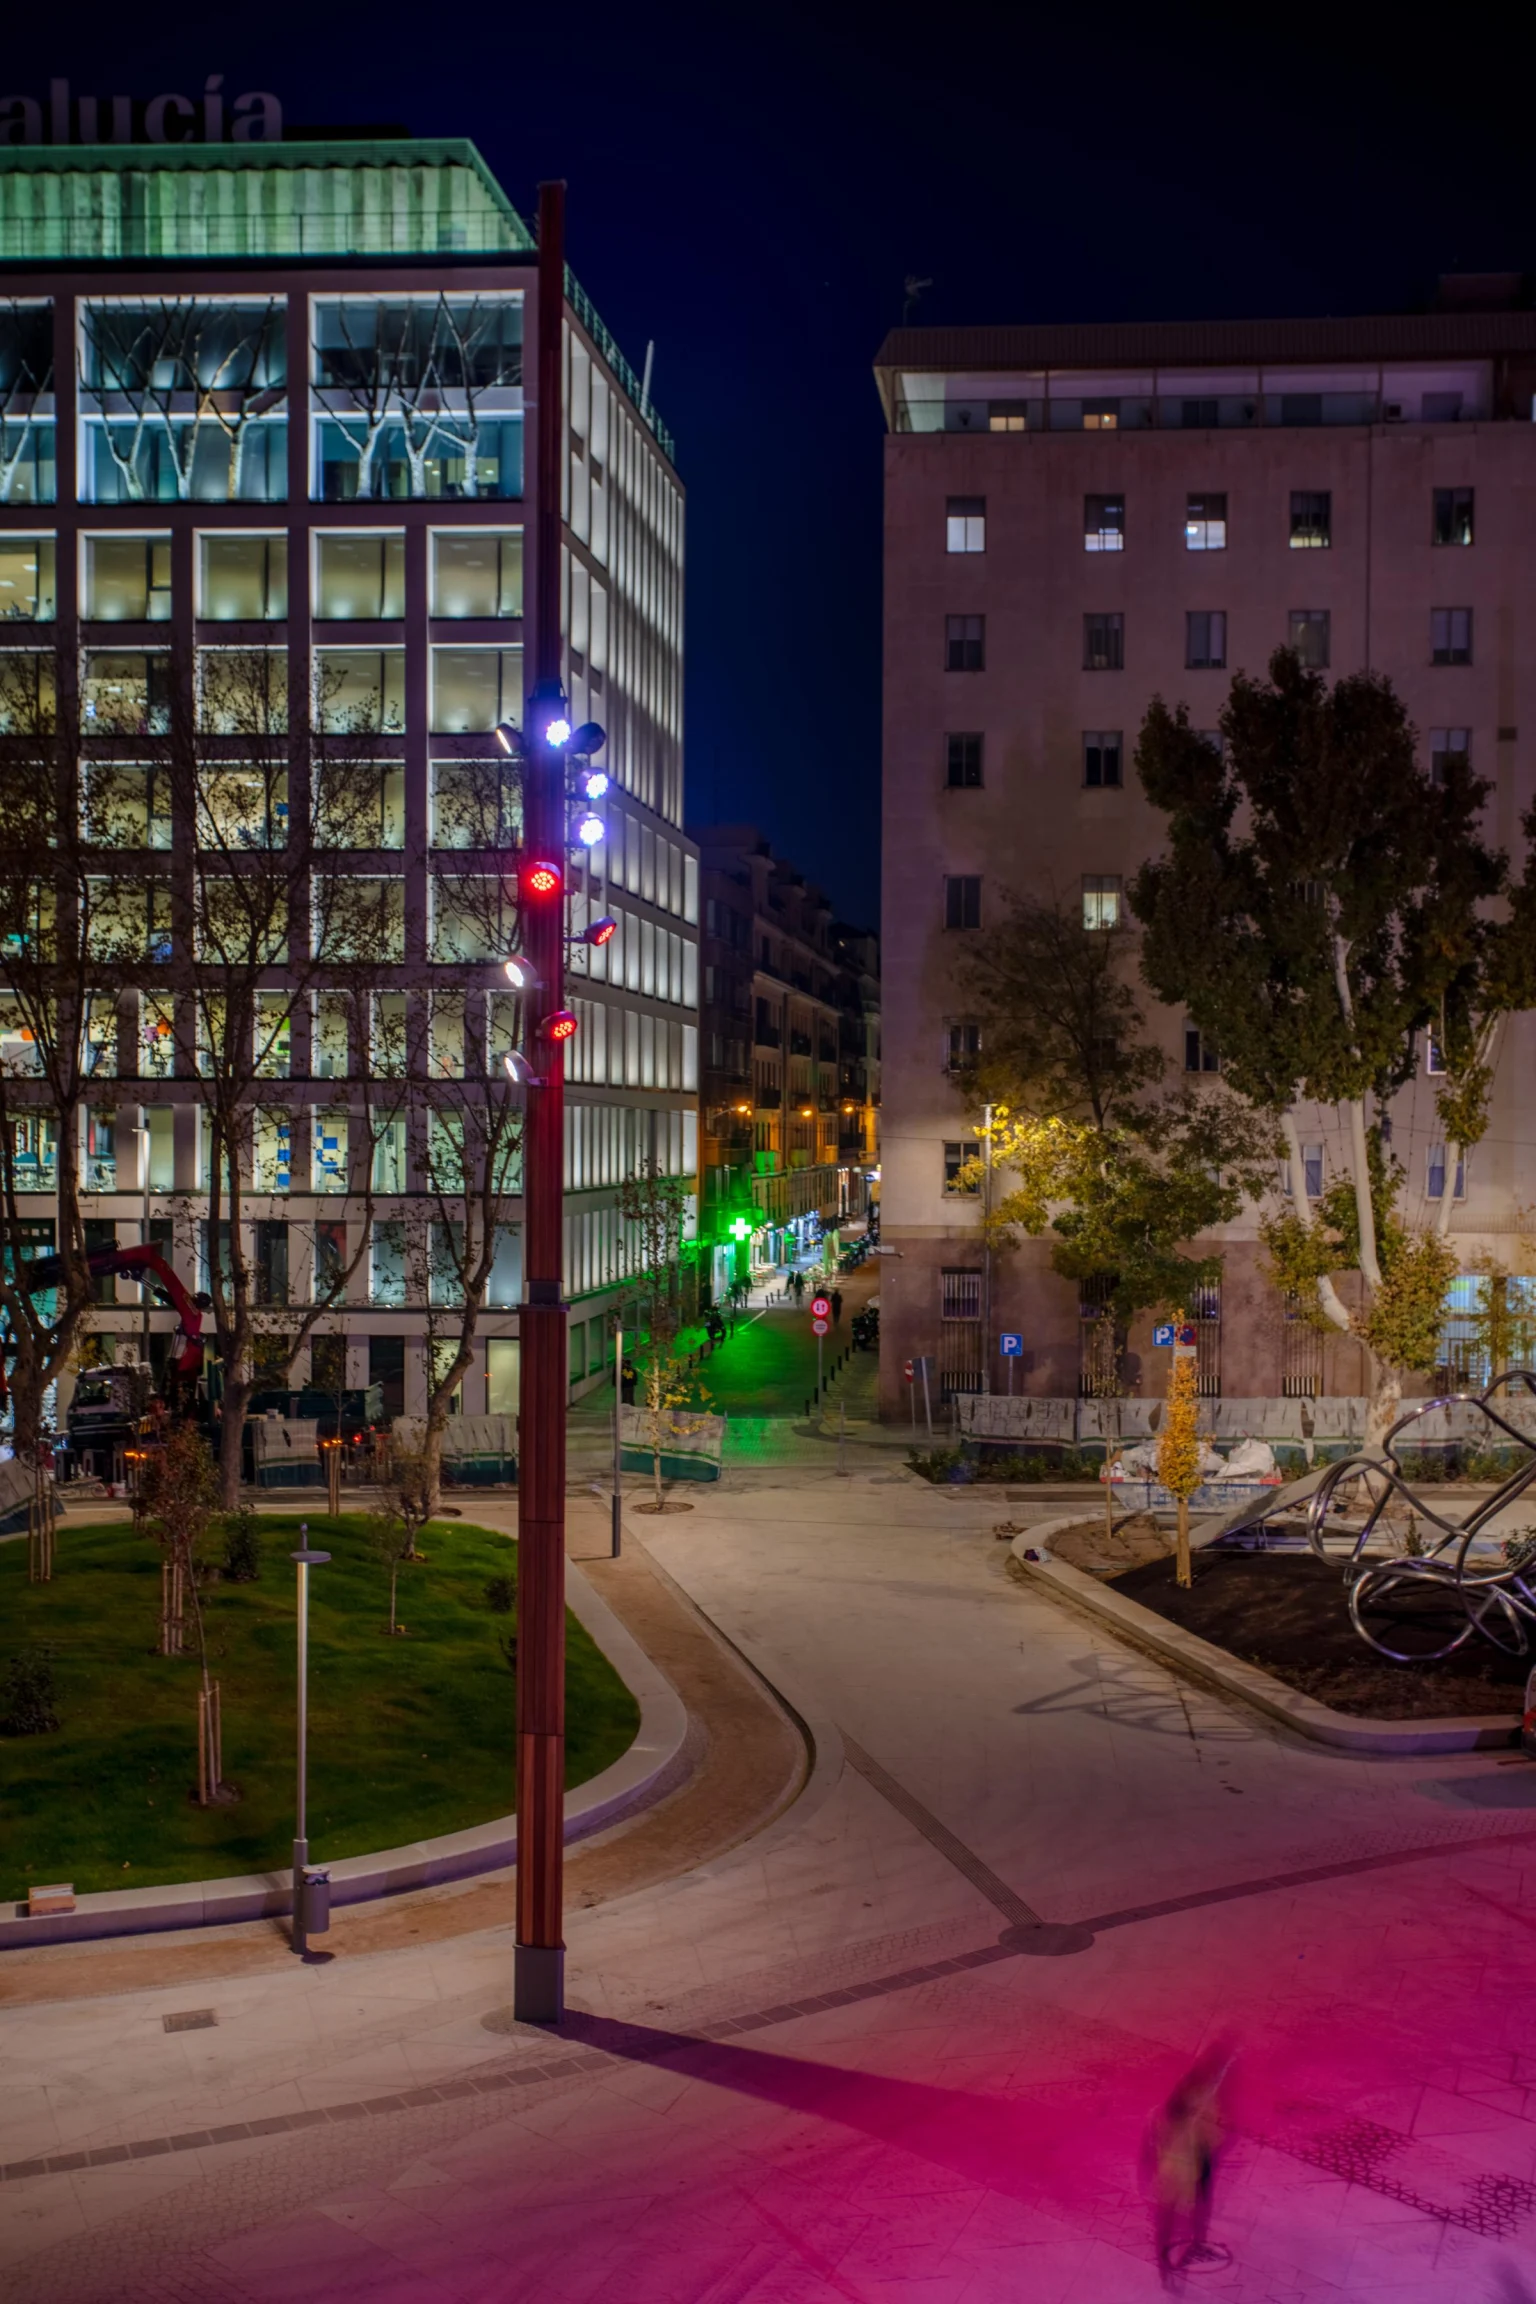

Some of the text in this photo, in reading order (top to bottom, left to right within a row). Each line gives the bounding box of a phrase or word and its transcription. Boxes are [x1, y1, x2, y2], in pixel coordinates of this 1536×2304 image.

[0, 74, 283, 144] alucía
[1156, 1326, 1170, 1344] P
[1003, 1336, 1018, 1354] P
